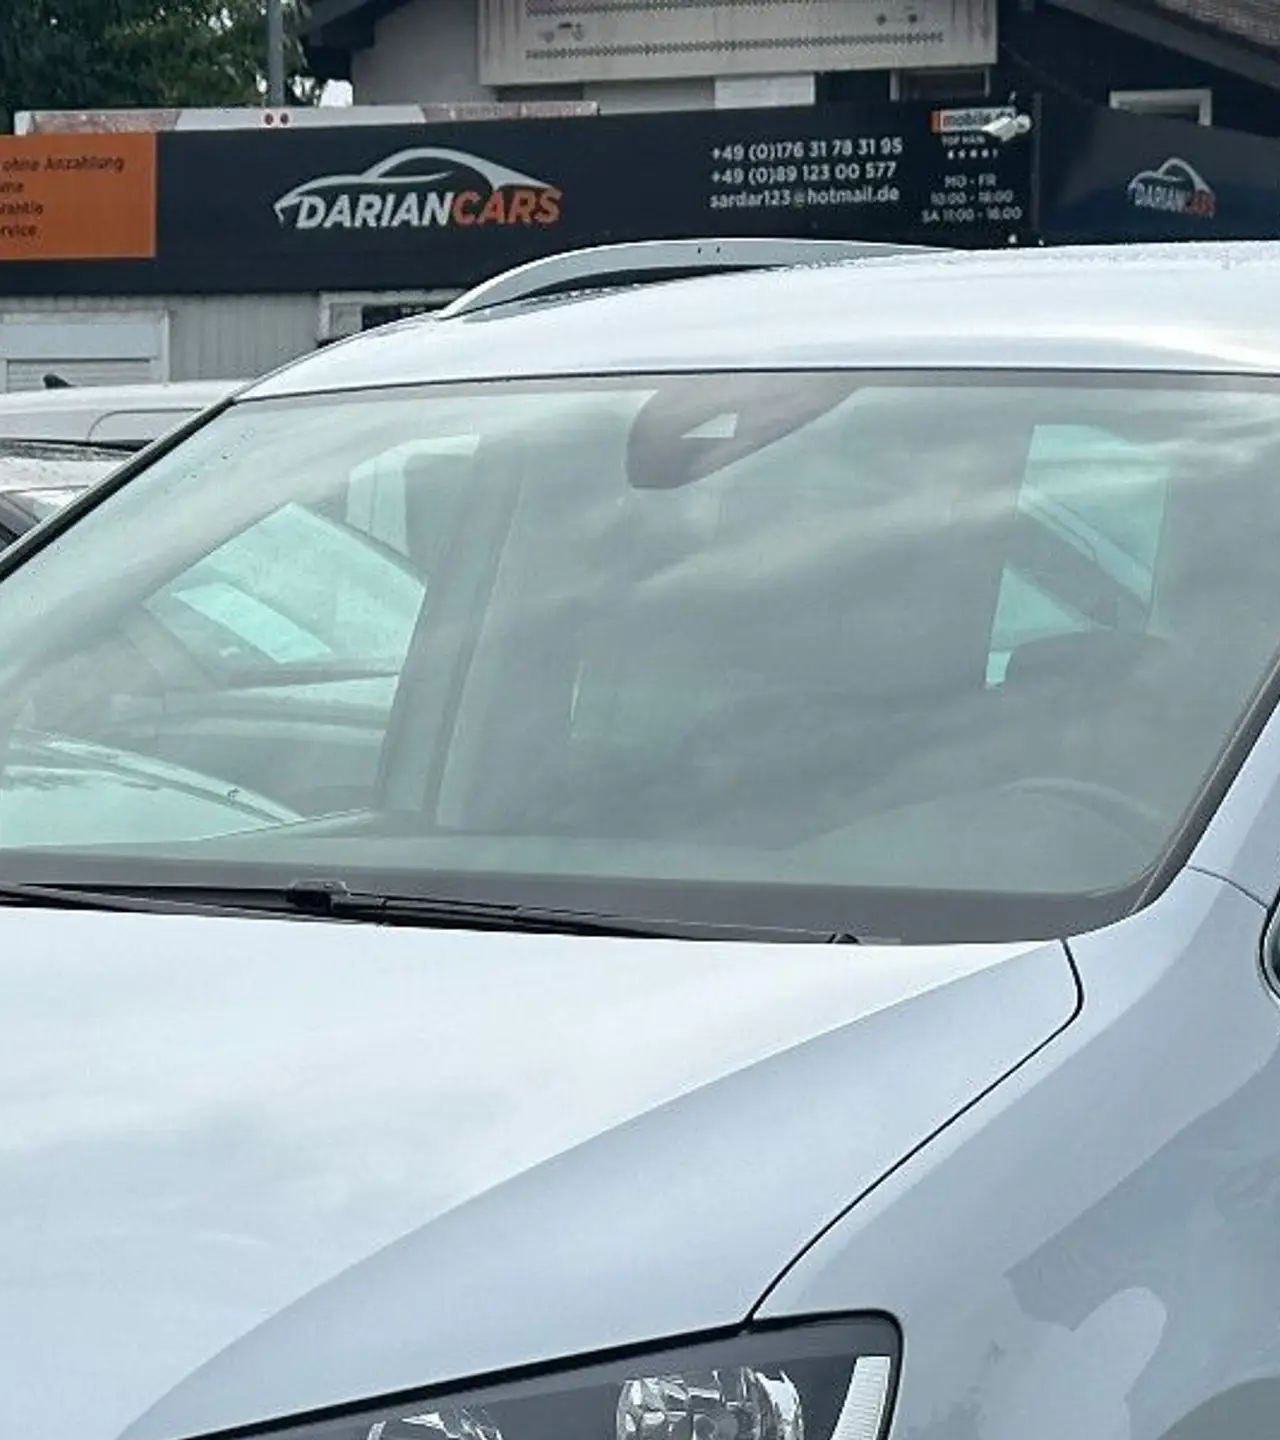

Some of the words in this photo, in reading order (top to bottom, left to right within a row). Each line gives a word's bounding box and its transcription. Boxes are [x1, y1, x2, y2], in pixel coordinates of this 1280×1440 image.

[711, 143, 745, 161] +49
[748, 141, 805, 161] (0)176
[808, 140, 827, 157] 31
[857, 138, 876, 155] 31
[880, 136, 904, 155] 95
[3, 158, 40, 172] ohne
[43, 156, 125, 174] Anzahlung
[711, 166, 745, 184] +49
[748, 165, 798, 186] (0)89
[802, 163, 830, 182] 123
[834, 163, 861, 180] 00
[865, 161, 897, 179] 577
[294, 186, 564, 230] DARIANCARS
